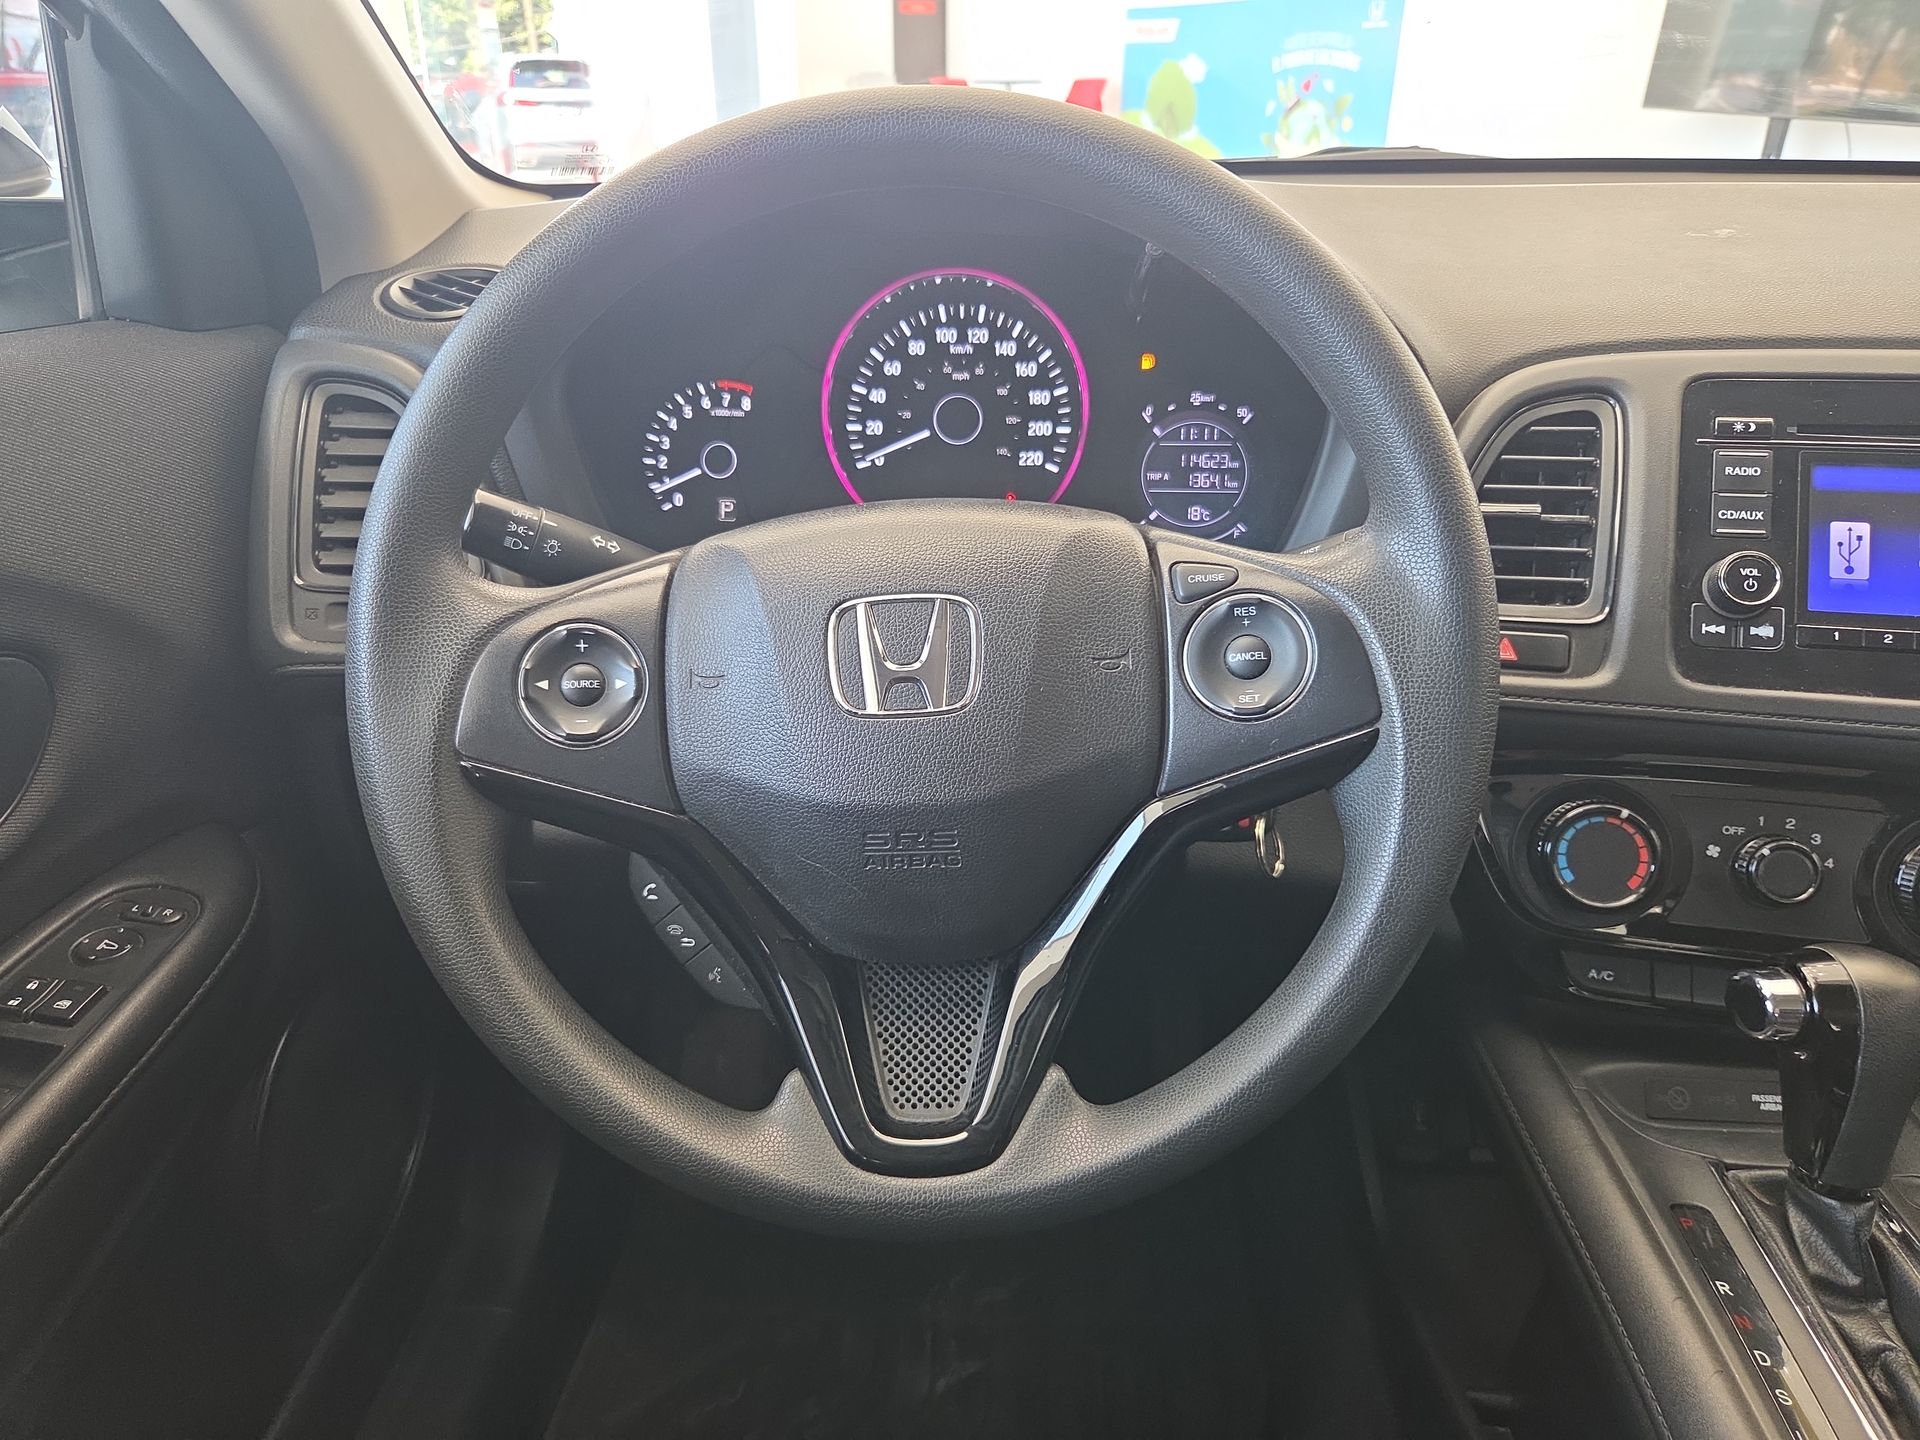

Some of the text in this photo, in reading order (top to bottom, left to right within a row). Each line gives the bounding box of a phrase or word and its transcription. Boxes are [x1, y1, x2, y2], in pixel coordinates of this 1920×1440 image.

[935, 328, 957, 344] 100
[967, 328, 989, 344] 120
[908, 340, 926, 356] 80
[950, 344, 973, 355] km/h
[994, 340, 1017, 357] 140
[883, 360, 901, 376] 60
[1015, 361, 1037, 377] 160
[952, 372, 970, 381] mph
[701, 394, 711, 409] 6
[721, 391, 731, 407] 7
[740, 395, 751, 411] 8
[868, 388, 886, 404] 40
[1028, 389, 1051, 406] 180
[682, 404, 693, 419] 5
[667, 416, 677, 431] 4
[865, 420, 883, 436] 20
[1028, 421, 1052, 437] 200
[659, 434, 670, 450] 3
[1180, 428, 1218, 441] 11:11
[657, 454, 667, 469] 2
[1018, 451, 1043, 466] 220
[1146, 473, 1162, 481] TRIP
[1163, 473, 1169, 481] A
[1725, 467, 1761, 476] RADIO
[672, 492, 683, 507] 0
[512, 508, 533, 520] OFF
[720, 501, 734, 519] P
[1718, 510, 1764, 520] CD/AUX
[1187, 573, 1225, 583] CRUISE
[1740, 568, 1761, 576] VOL
[1234, 606, 1257, 617] RES
[1833, 631, 1840, 641] 1
[1883, 634, 1894, 644] 2
[1228, 651, 1267, 662] CANCEL
[563, 680, 600, 689] SOURCE
[1238, 694, 1261, 703] SET
[1758, 816, 1764, 826] 1
[1785, 818, 1796, 829] 2
[1722, 825, 1745, 836] OFF
[863, 829, 959, 850] SRS
[1810, 834, 1821, 845] 3
[863, 856, 962, 870] AIRBAG
[1824, 857, 1835, 869] 4
[1587, 968, 1615, 982] A/C
[1679, 1217, 1693, 1231] P
[1714, 1280, 1734, 1297] R
[1733, 1315, 1754, 1330] N
[1753, 1350, 1771, 1367] D
[1774, 1389, 1793, 1406] S
